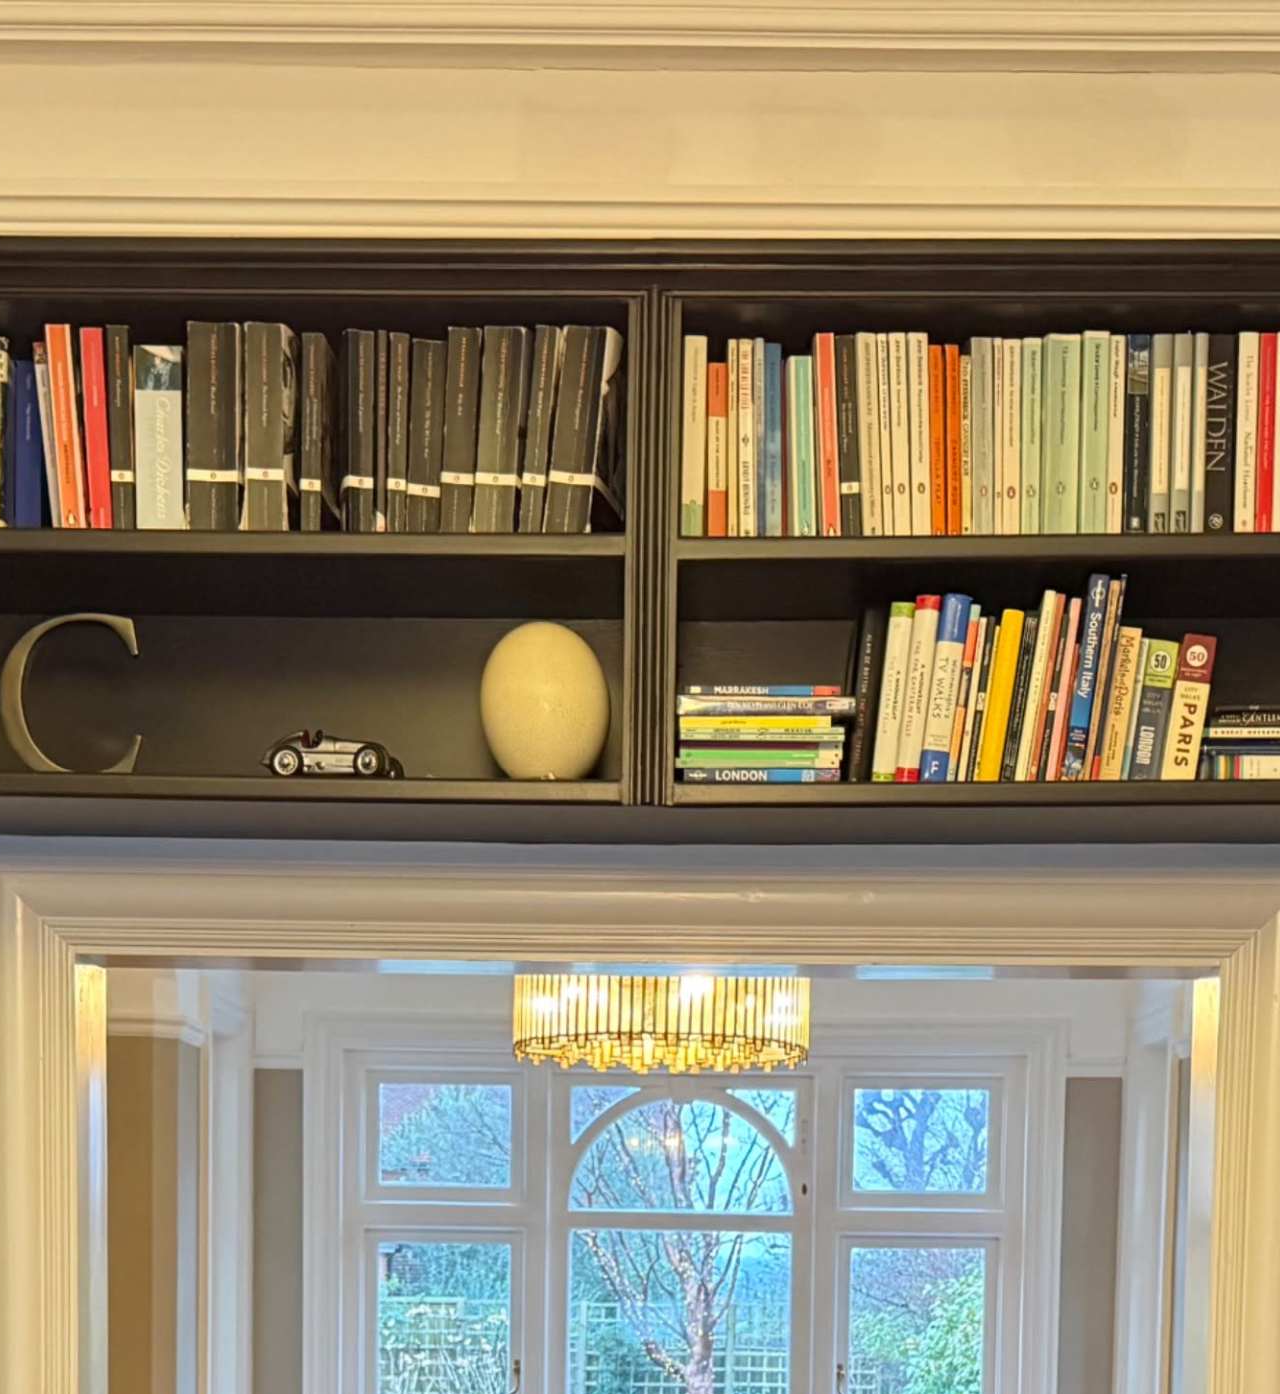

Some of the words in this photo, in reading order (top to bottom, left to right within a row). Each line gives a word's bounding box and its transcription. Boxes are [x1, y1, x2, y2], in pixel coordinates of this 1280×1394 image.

[1083, 612, 1102, 669] Southern
[714, 686, 769, 695] MARRAKESH
[1079, 671, 1094, 699] Italy
[1135, 725, 1155, 765] LONDON
[1174, 703, 1197, 768] PARIS
[715, 770, 768, 782] LONDON
